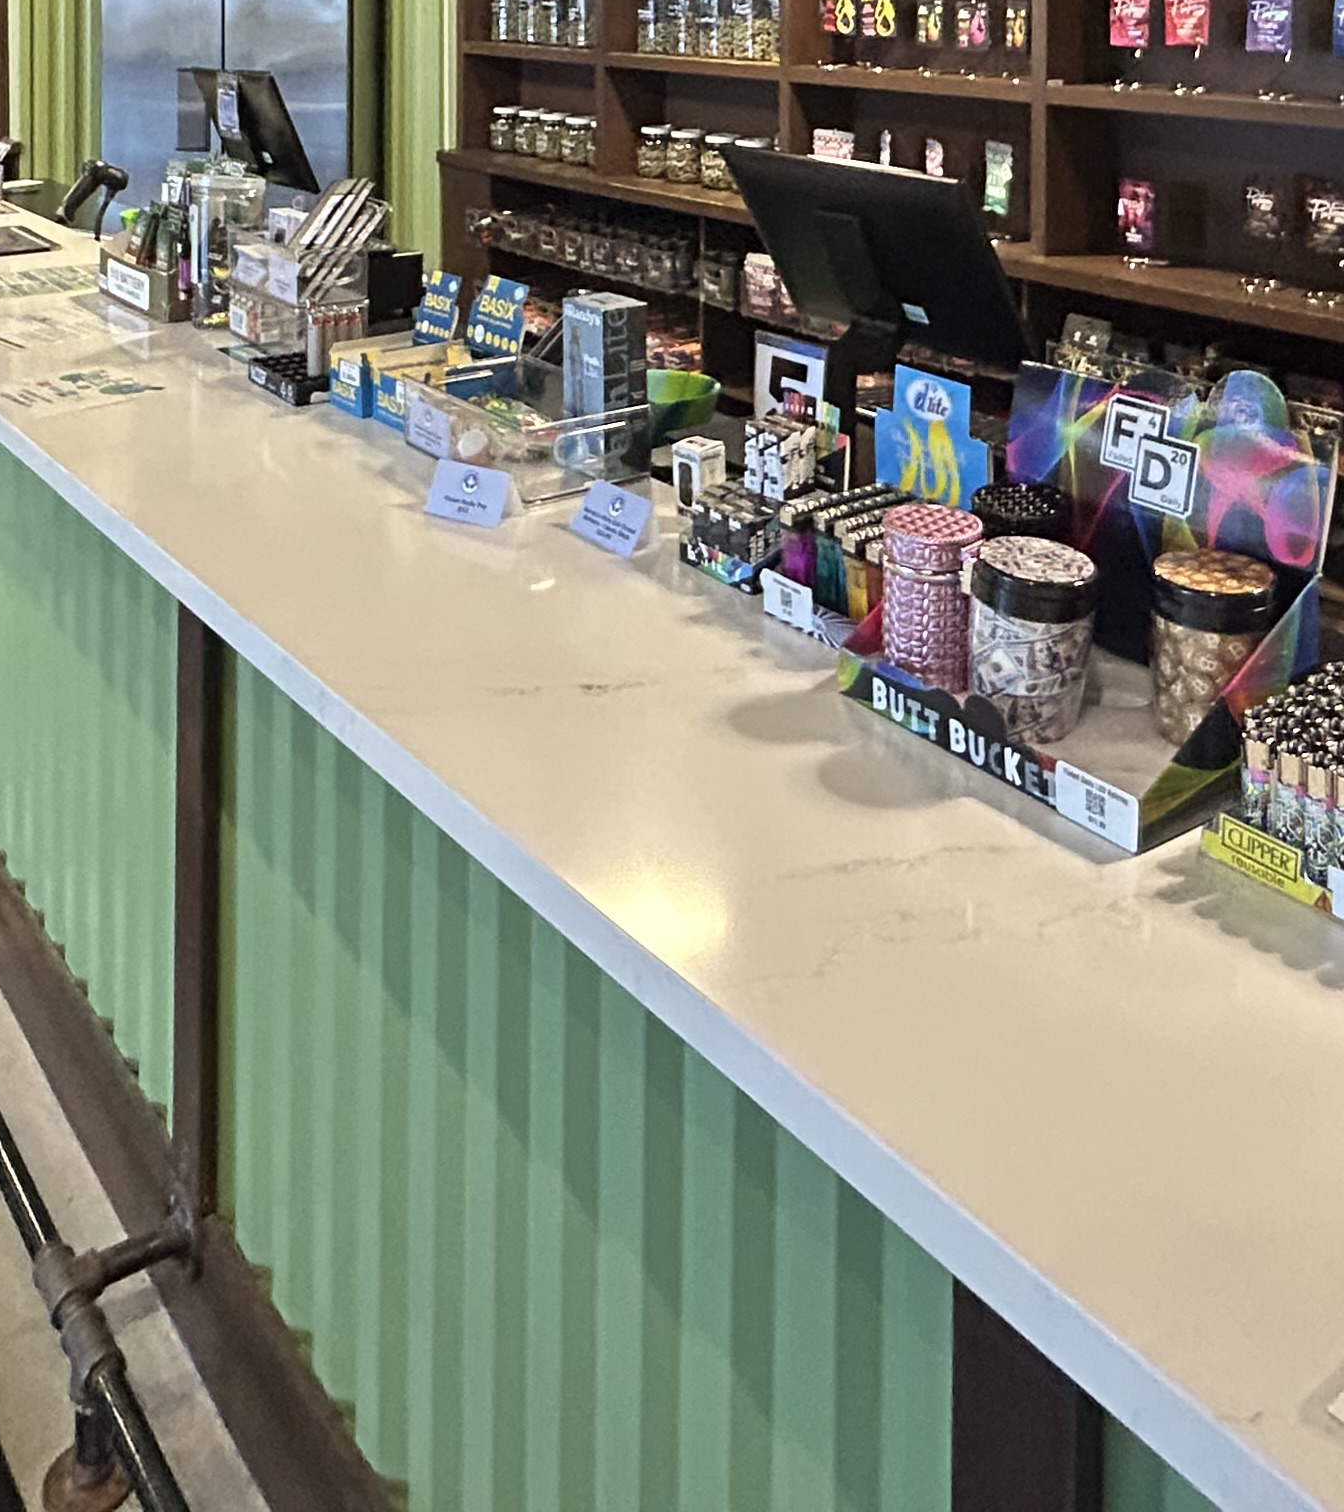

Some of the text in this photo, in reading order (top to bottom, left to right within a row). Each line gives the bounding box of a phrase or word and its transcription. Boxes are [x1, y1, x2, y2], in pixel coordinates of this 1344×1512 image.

[479, 294, 517, 321] BASIX
[1111, 411, 1139, 448] F
[1148, 416, 1157, 429] 4
[1140, 449, 1172, 491] D
[1170, 450, 1188, 466] 20
[1160, 495, 1181, 510] Daily
[872, 676, 1056, 806] BUTT BUCKET
[1228, 826, 1290, 872] CLIPPER
[1231, 854, 1286, 888] reusable
